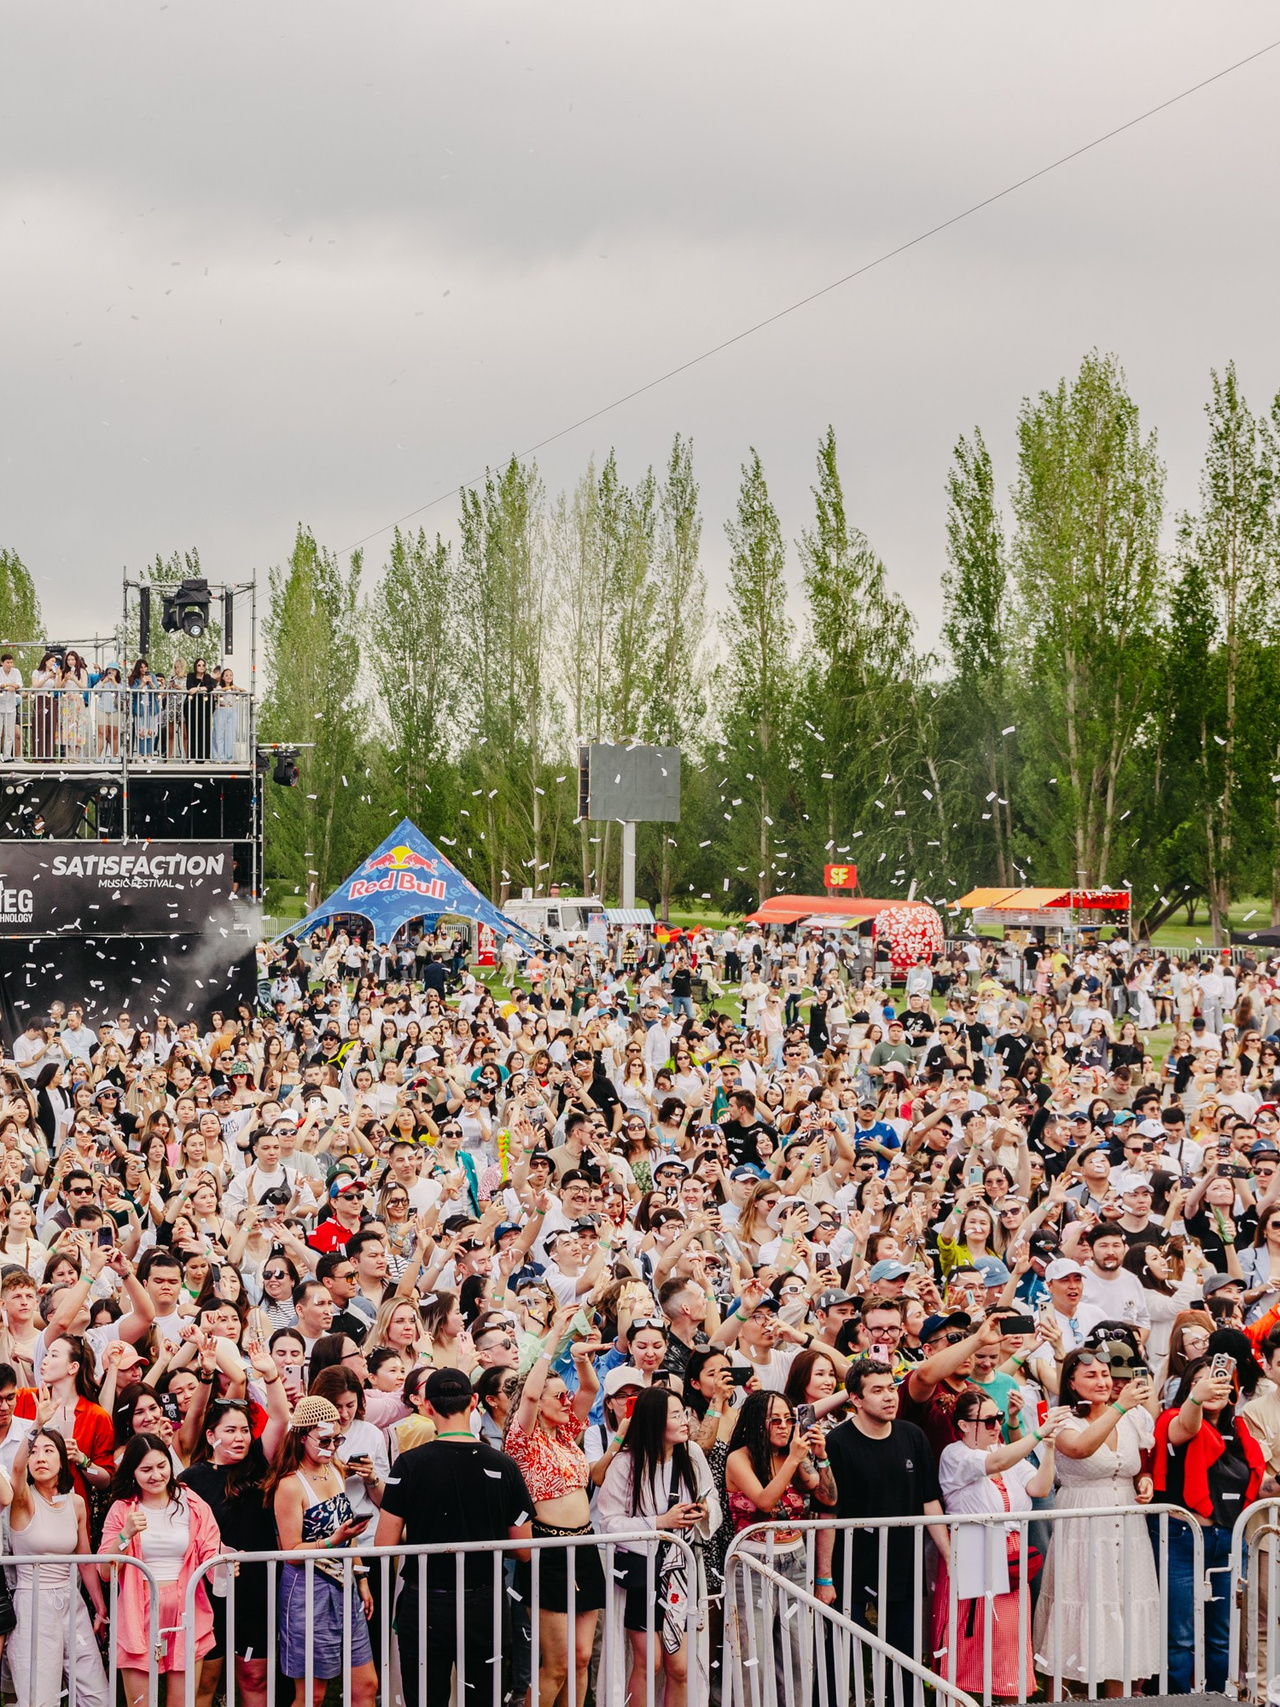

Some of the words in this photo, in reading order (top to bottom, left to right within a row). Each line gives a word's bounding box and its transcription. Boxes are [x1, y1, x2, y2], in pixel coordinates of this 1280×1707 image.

[51, 855, 224, 876] SATISFACTION
[98, 879, 129, 889] MUSIC
[349, 870, 395, 900] Red
[397, 871, 447, 900] Bull
[830, 867, 849, 885] SF
